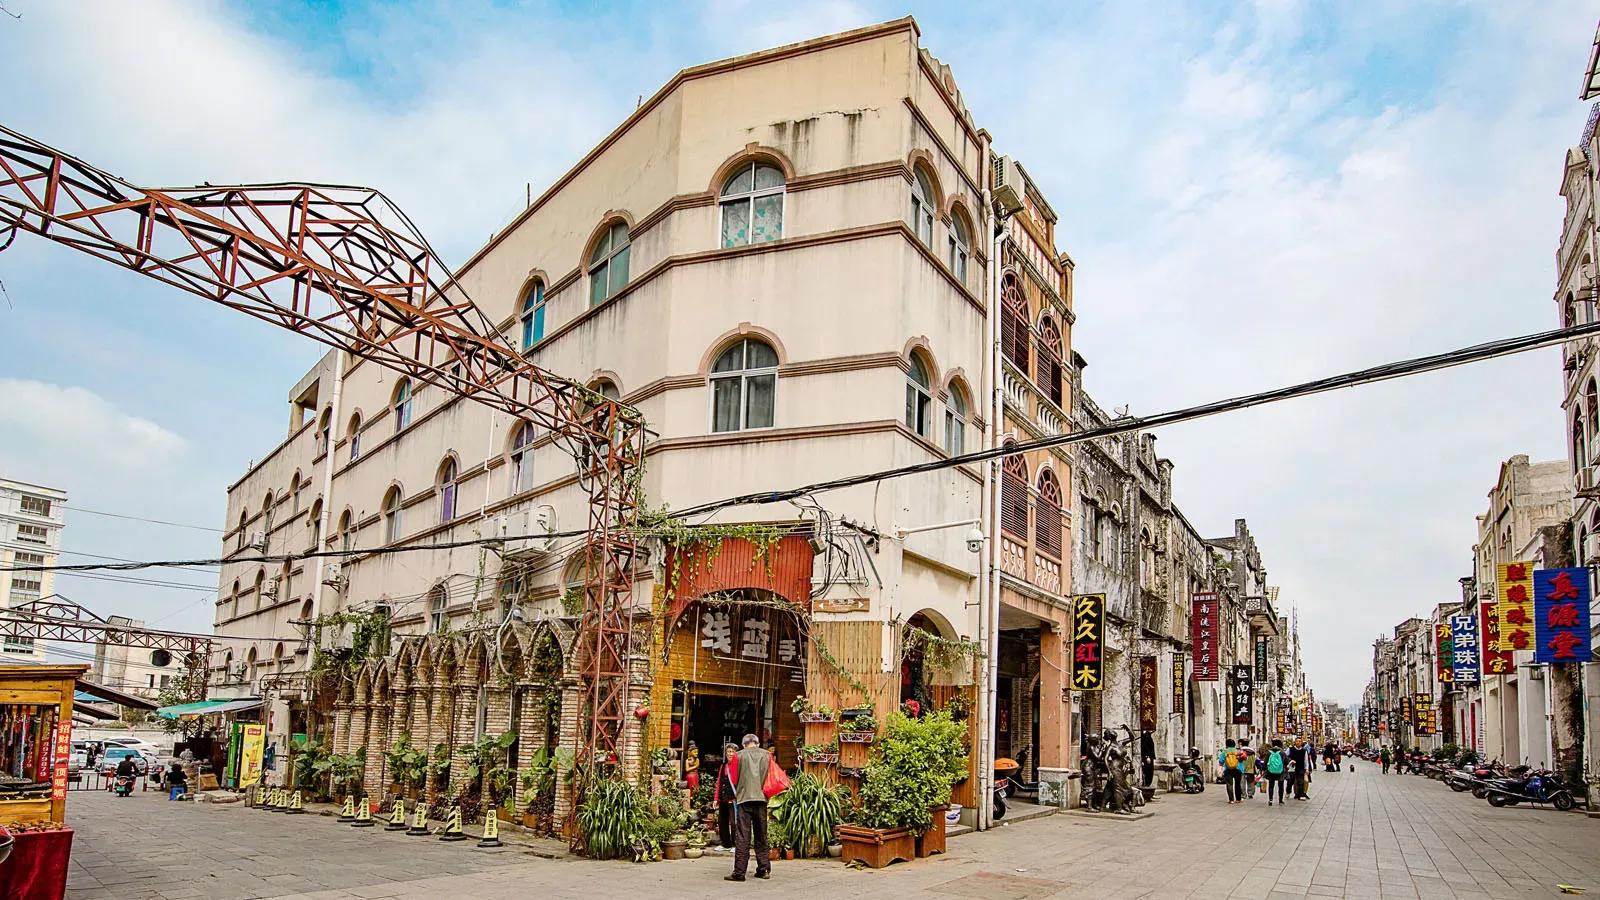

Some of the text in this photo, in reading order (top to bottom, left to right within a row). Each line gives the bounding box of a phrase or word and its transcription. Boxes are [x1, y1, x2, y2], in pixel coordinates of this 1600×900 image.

[1075, 597, 1098, 687] 久久红木
[1454, 616, 1478, 682] 兄弟珠宝
[1546, 571, 1581, 660] 真源堂
[1235, 669, 1249, 717] 越南特产
